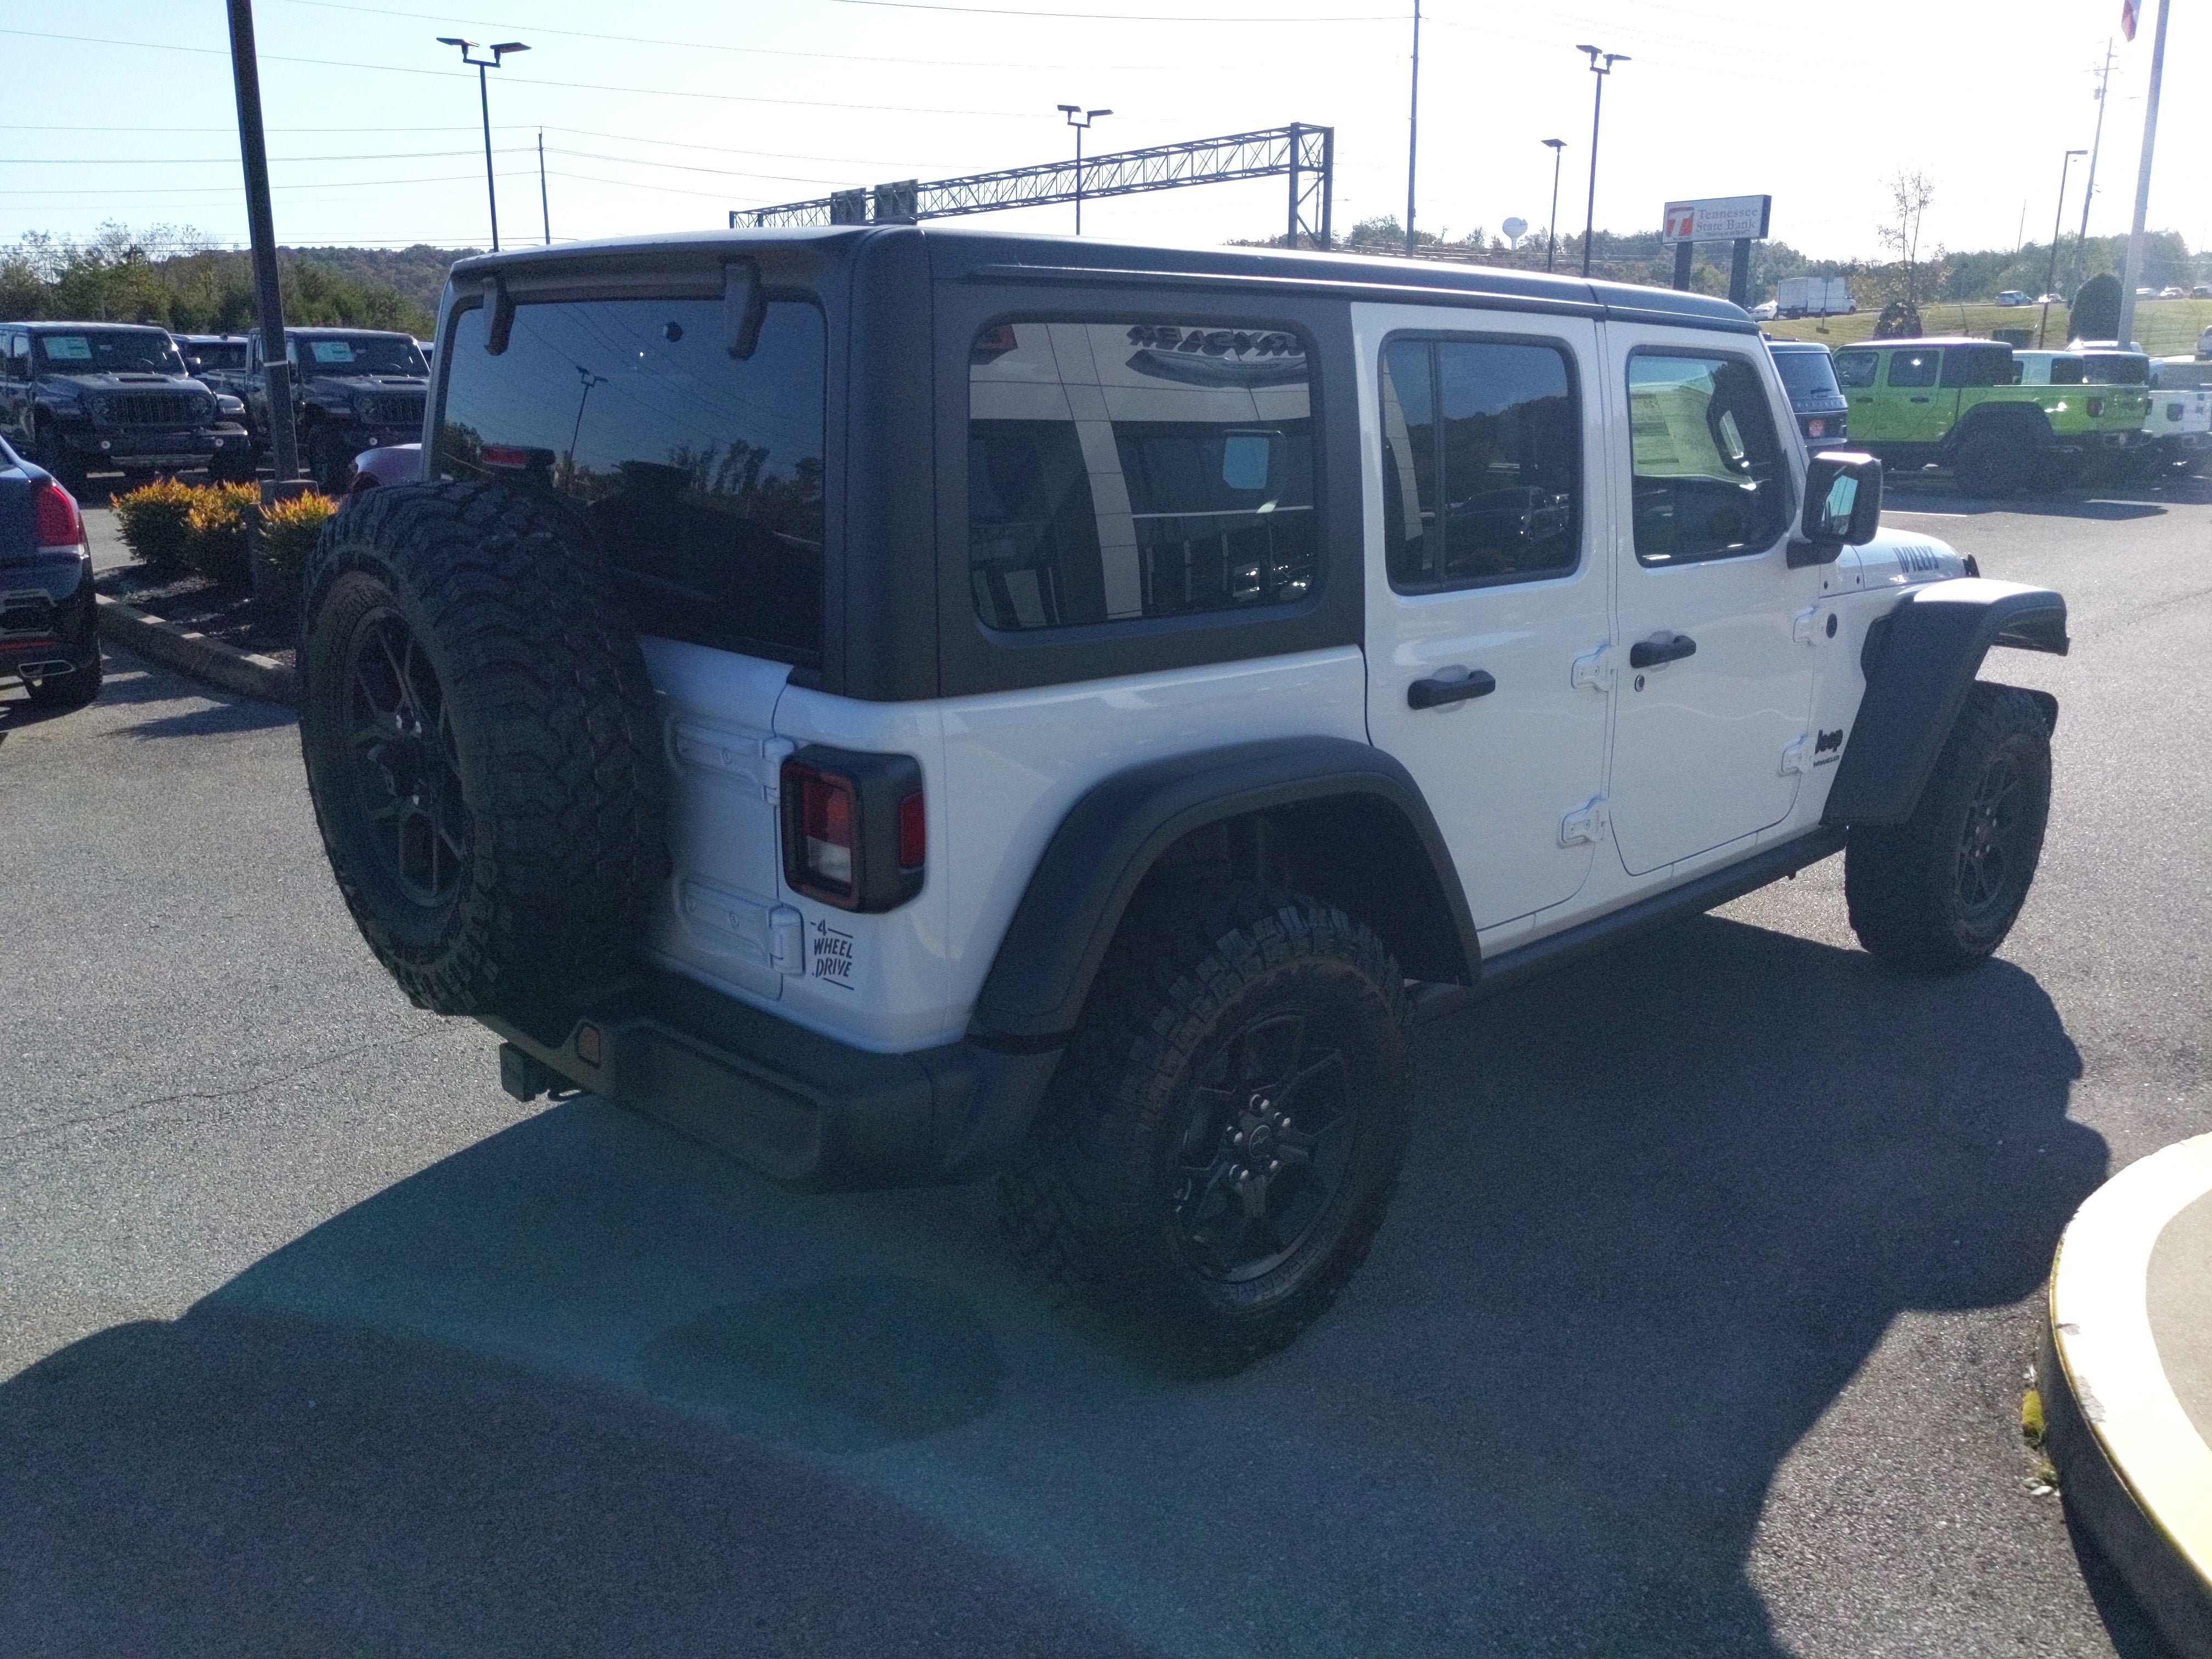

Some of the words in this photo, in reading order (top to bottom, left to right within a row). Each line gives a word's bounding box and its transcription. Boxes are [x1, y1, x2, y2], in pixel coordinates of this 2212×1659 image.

[1698, 208, 1758, 219] Tennessee
[1696, 222, 1723, 232] State
[1727, 219, 1756, 230] Bank
[1892, 546, 1939, 573] WILLYS
[1815, 729, 1843, 754] Jeep
[814, 938, 853, 958] WHEEL
[815, 958, 852, 978] DRIVE
